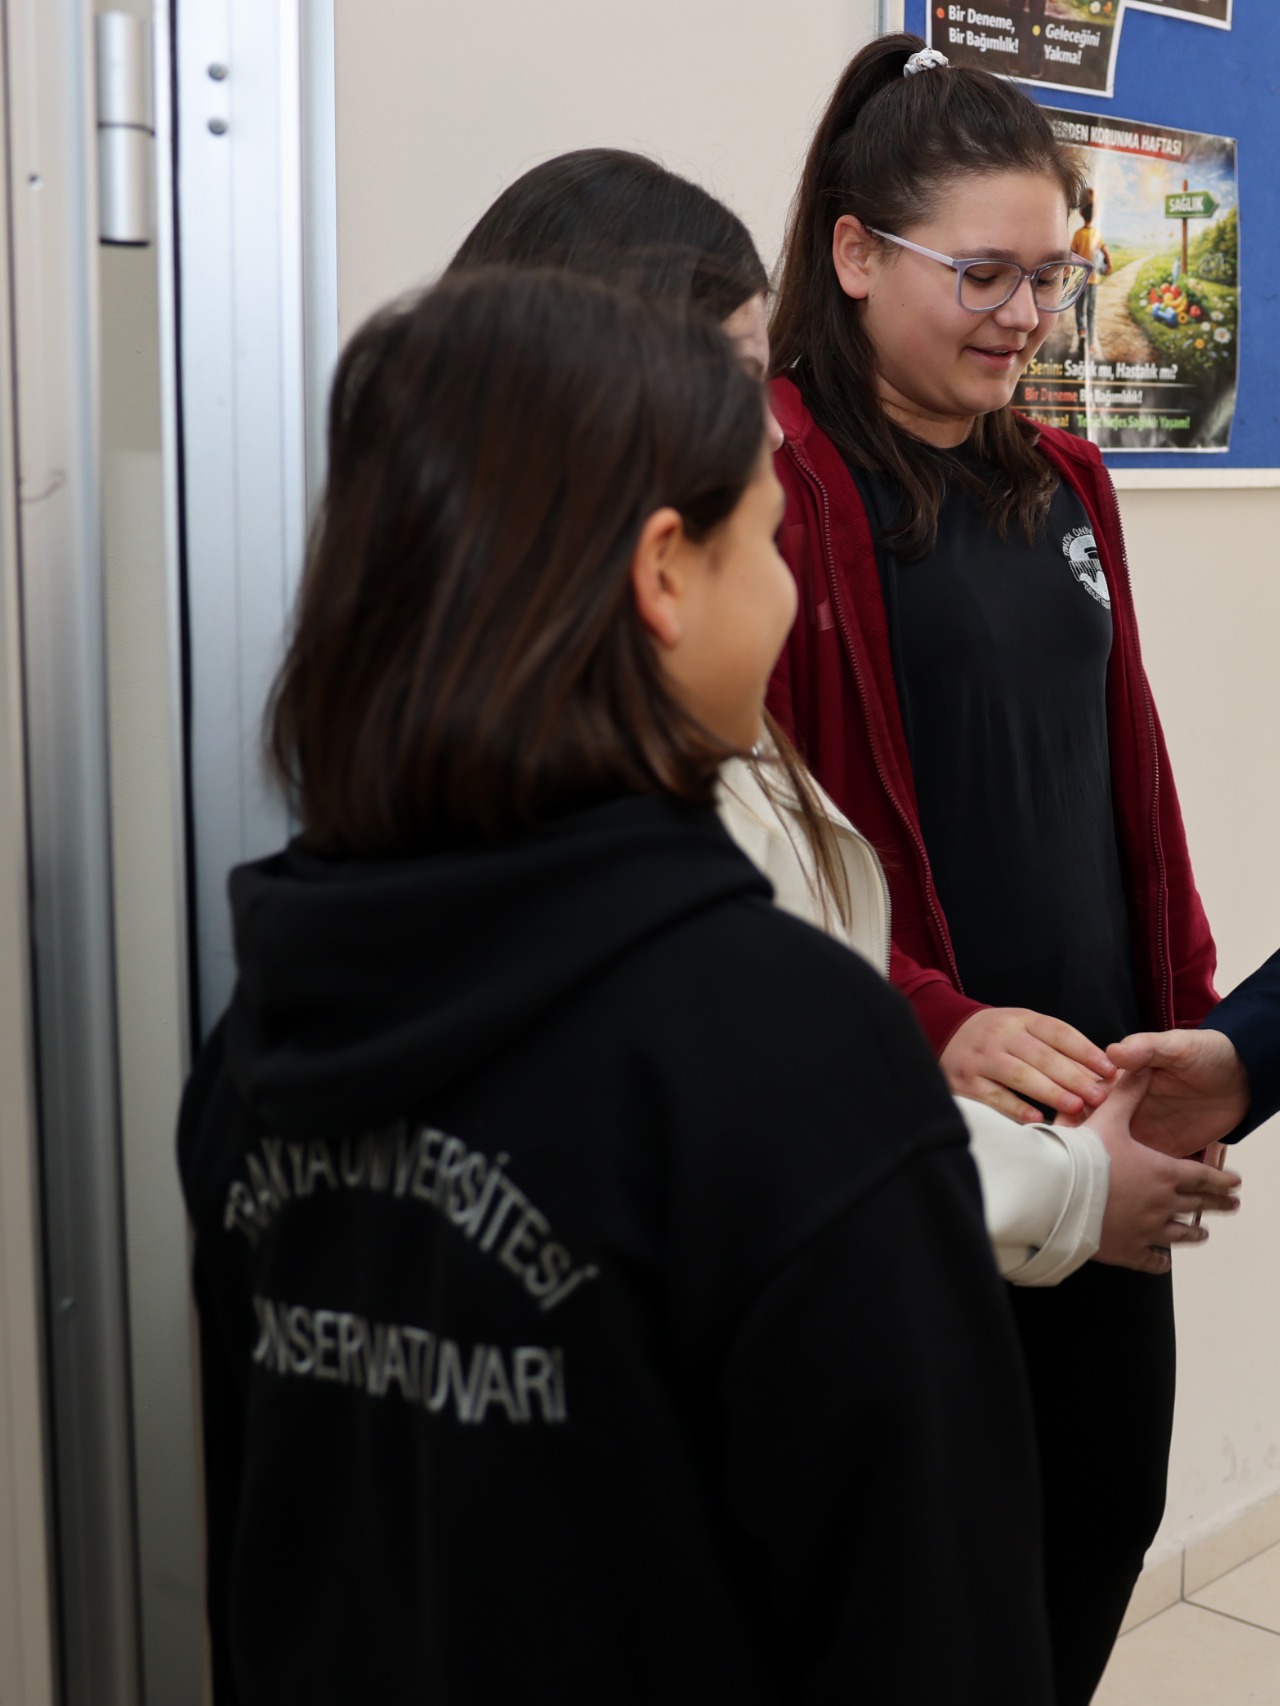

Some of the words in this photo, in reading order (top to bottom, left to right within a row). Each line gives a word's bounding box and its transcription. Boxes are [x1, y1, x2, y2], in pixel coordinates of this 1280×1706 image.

[948, 5, 965, 22] Bir
[968, 8, 1016, 34] Deneme,
[949, 27, 965, 45] Bir
[967, 30, 1020, 54] Bağımlılık!
[1045, 23, 1101, 48] Geleceğini
[1043, 44, 1082, 65] Yakma!
[1090, 126, 1140, 150] KORUNMA
[1141, 134, 1183, 156] HAFTASI
[1030, 358, 1063, 376] Senin:
[1064, 359, 1097, 380] Sağk
[1116, 362, 1158, 380] Hastalık
[1024, 386, 1039, 401] Bir
[1079, 388, 1093, 403] Br
[223, 1135, 339, 1247] RAKYA
[252, 1295, 568, 1424] NSERVATUVARI
